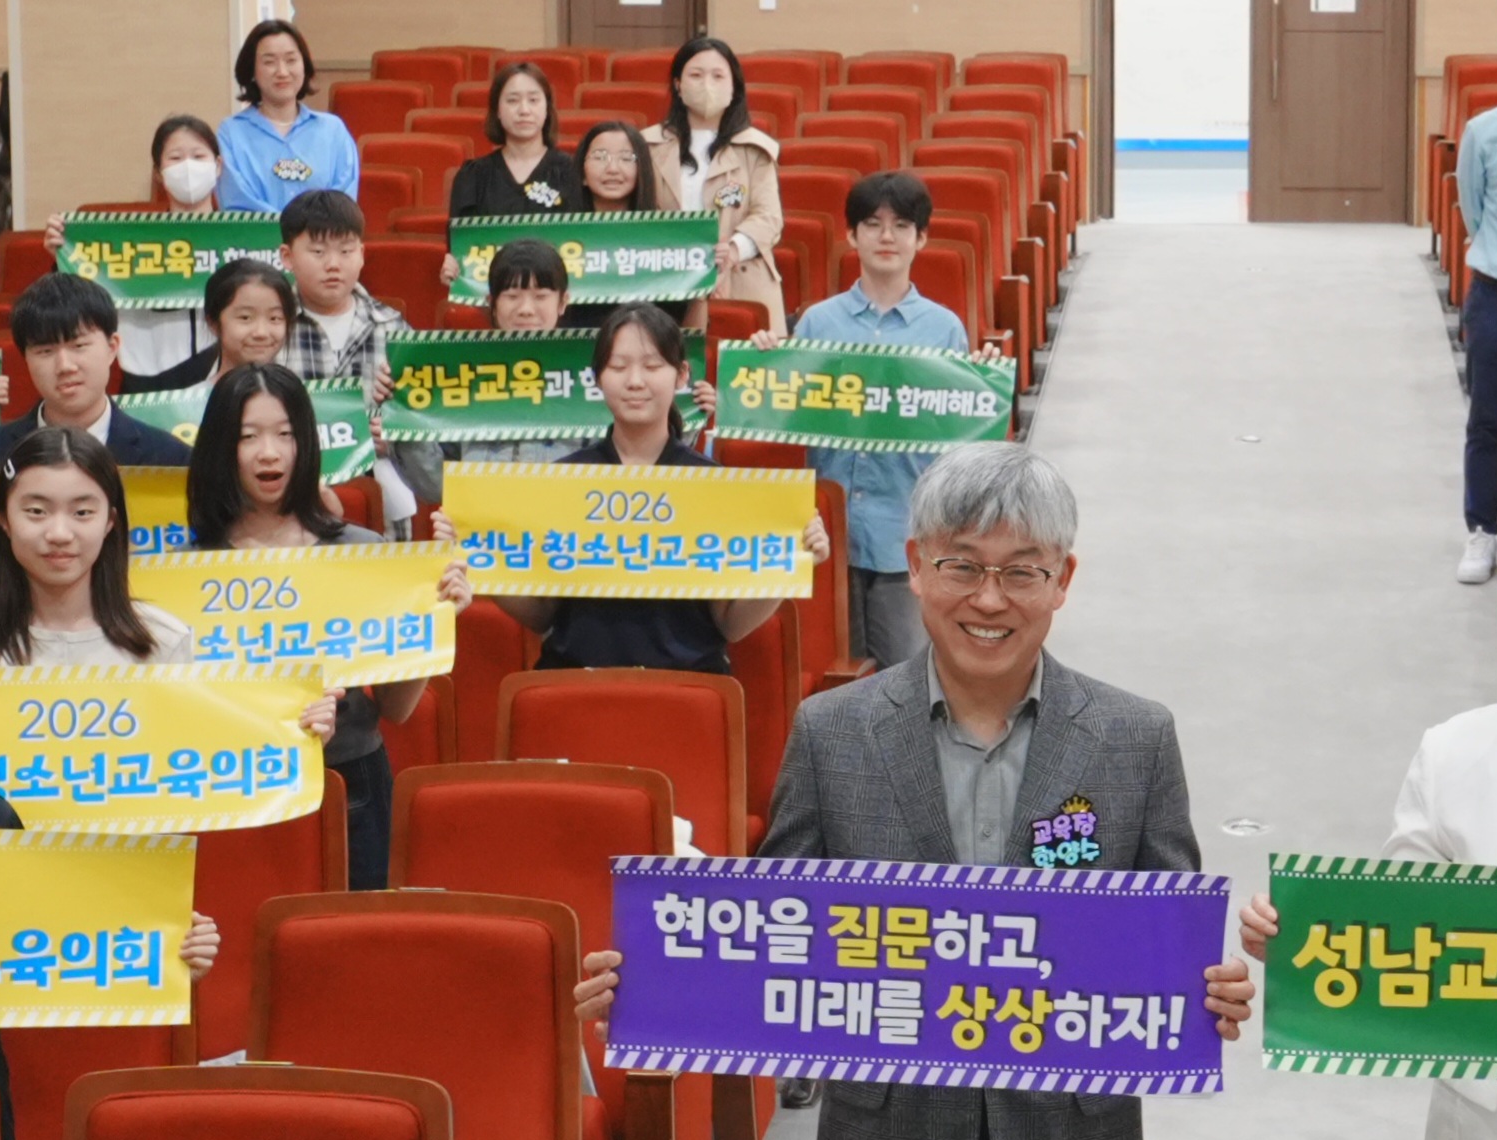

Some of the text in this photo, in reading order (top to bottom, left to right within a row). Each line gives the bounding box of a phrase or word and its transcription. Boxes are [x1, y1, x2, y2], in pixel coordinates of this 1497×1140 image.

[67, 240, 219, 279] 성남교육과
[463, 241, 708, 282] 성육과 함께해요
[394, 359, 575, 409] 성남교육과
[729, 366, 892, 417] 성남교육과
[896, 384, 997, 418] 함께해요
[585, 489, 674, 522] 2026
[460, 529, 795, 573] 성남 청소년교육의회
[200, 575, 299, 613] 2026
[190, 612, 434, 664] 소년교육의회
[17, 698, 138, 739] 2026
[1031, 811, 1098, 846] 교육장
[653, 892, 1054, 980] 현안을 질문하고,
[763, 978, 1184, 1054] 미래를 상상하자!
